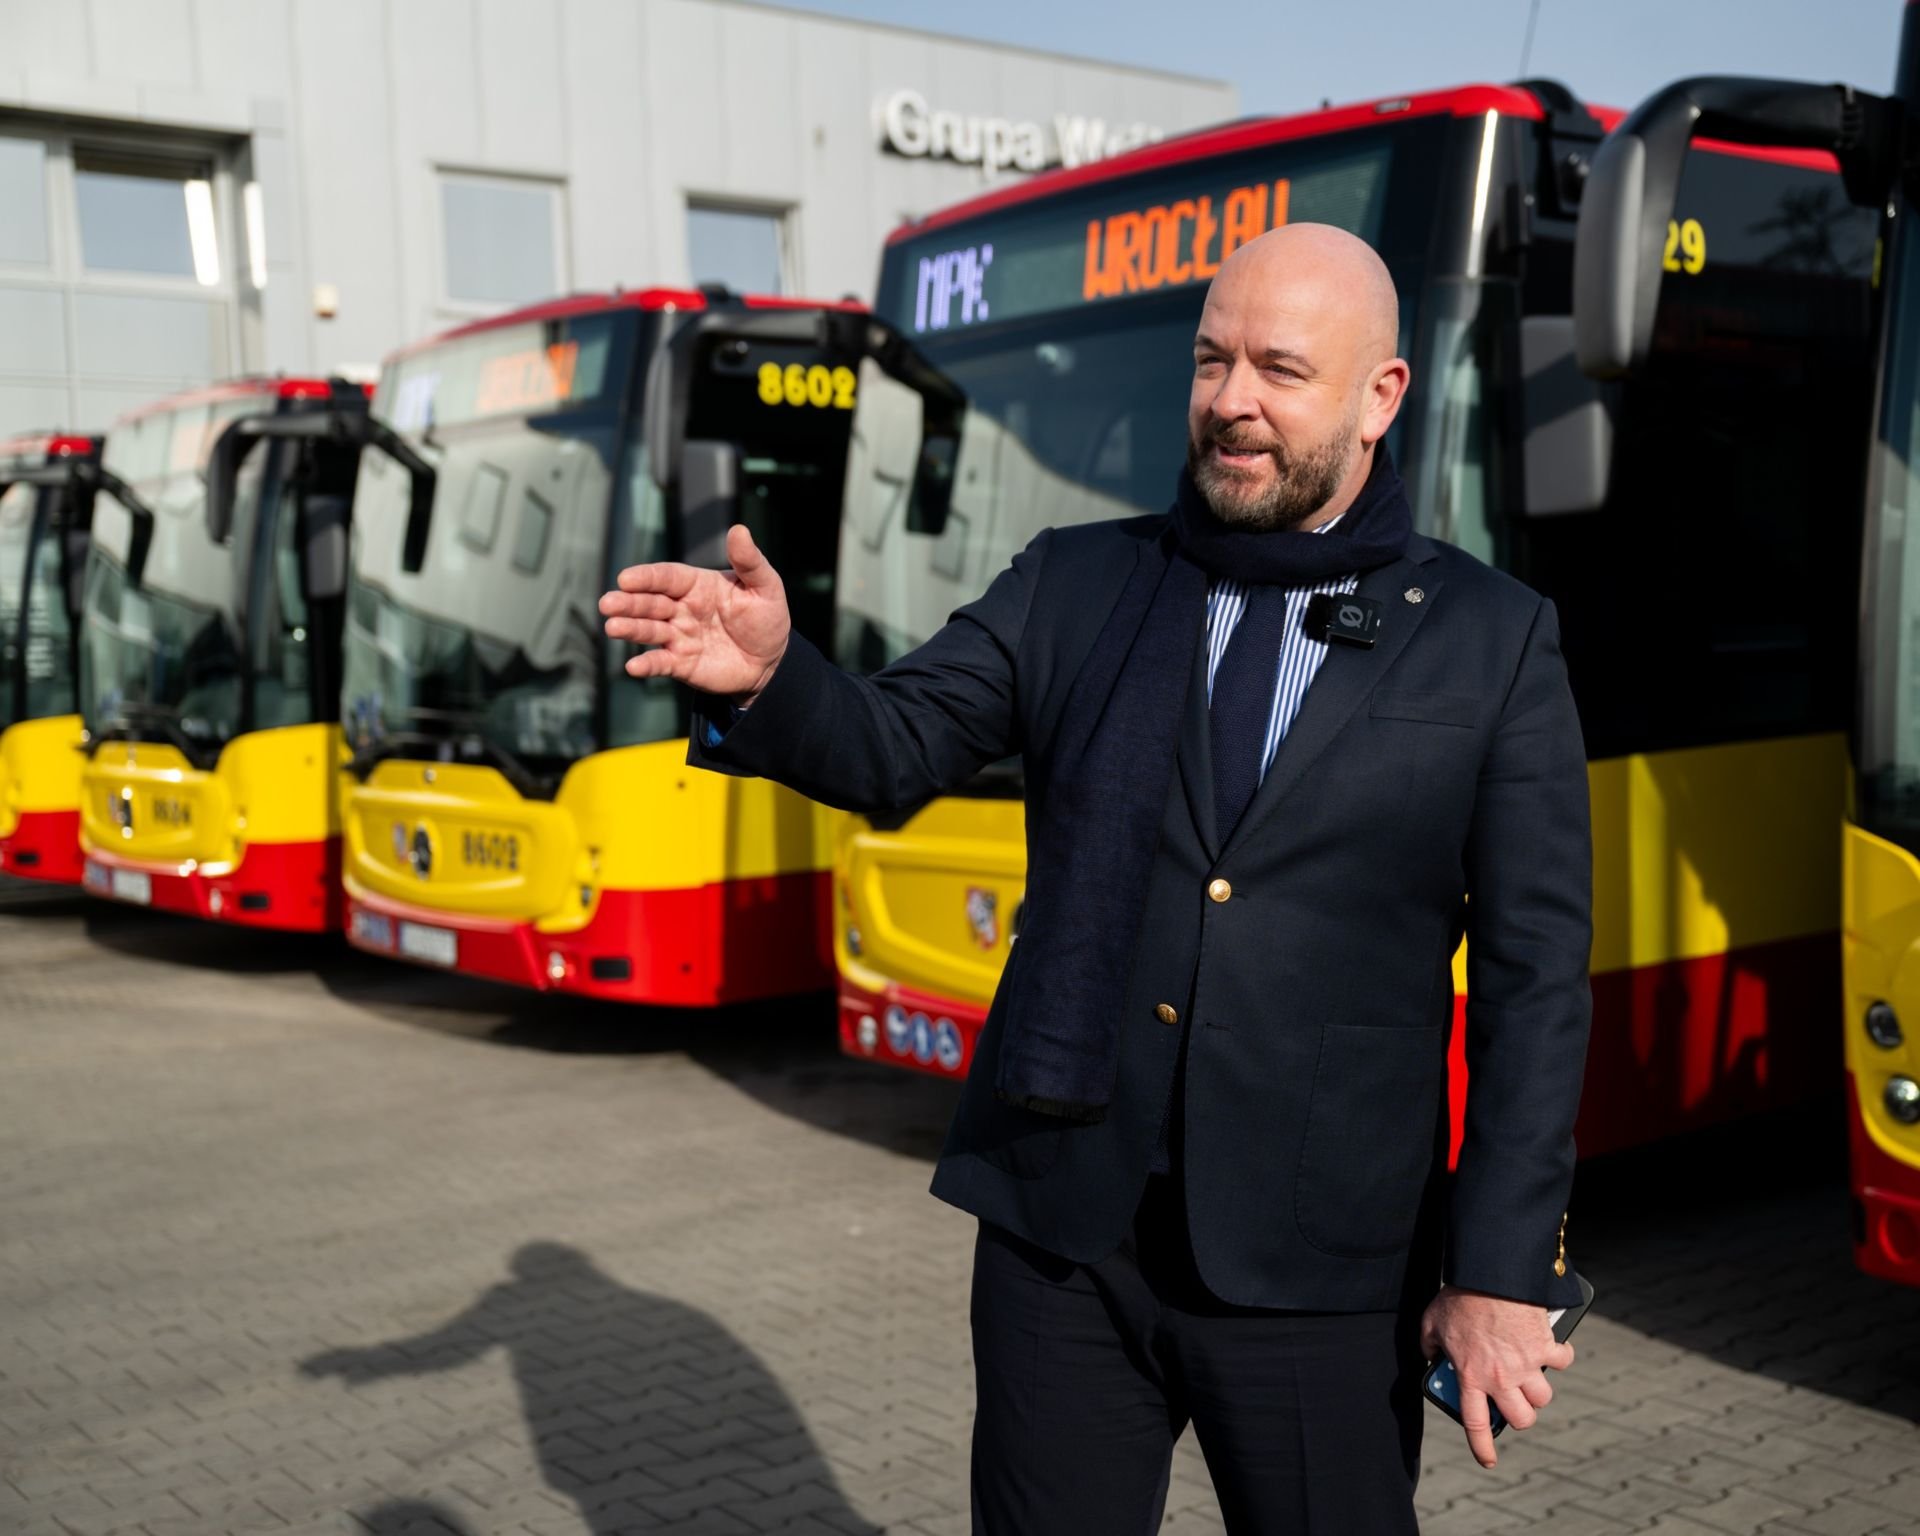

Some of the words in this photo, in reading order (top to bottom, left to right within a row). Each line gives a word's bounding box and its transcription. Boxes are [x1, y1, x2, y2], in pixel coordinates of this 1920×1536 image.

[885, 89, 1046, 179] Grupa
[914, 243, 993, 333] MPK
[757, 361, 856, 410] 8602
